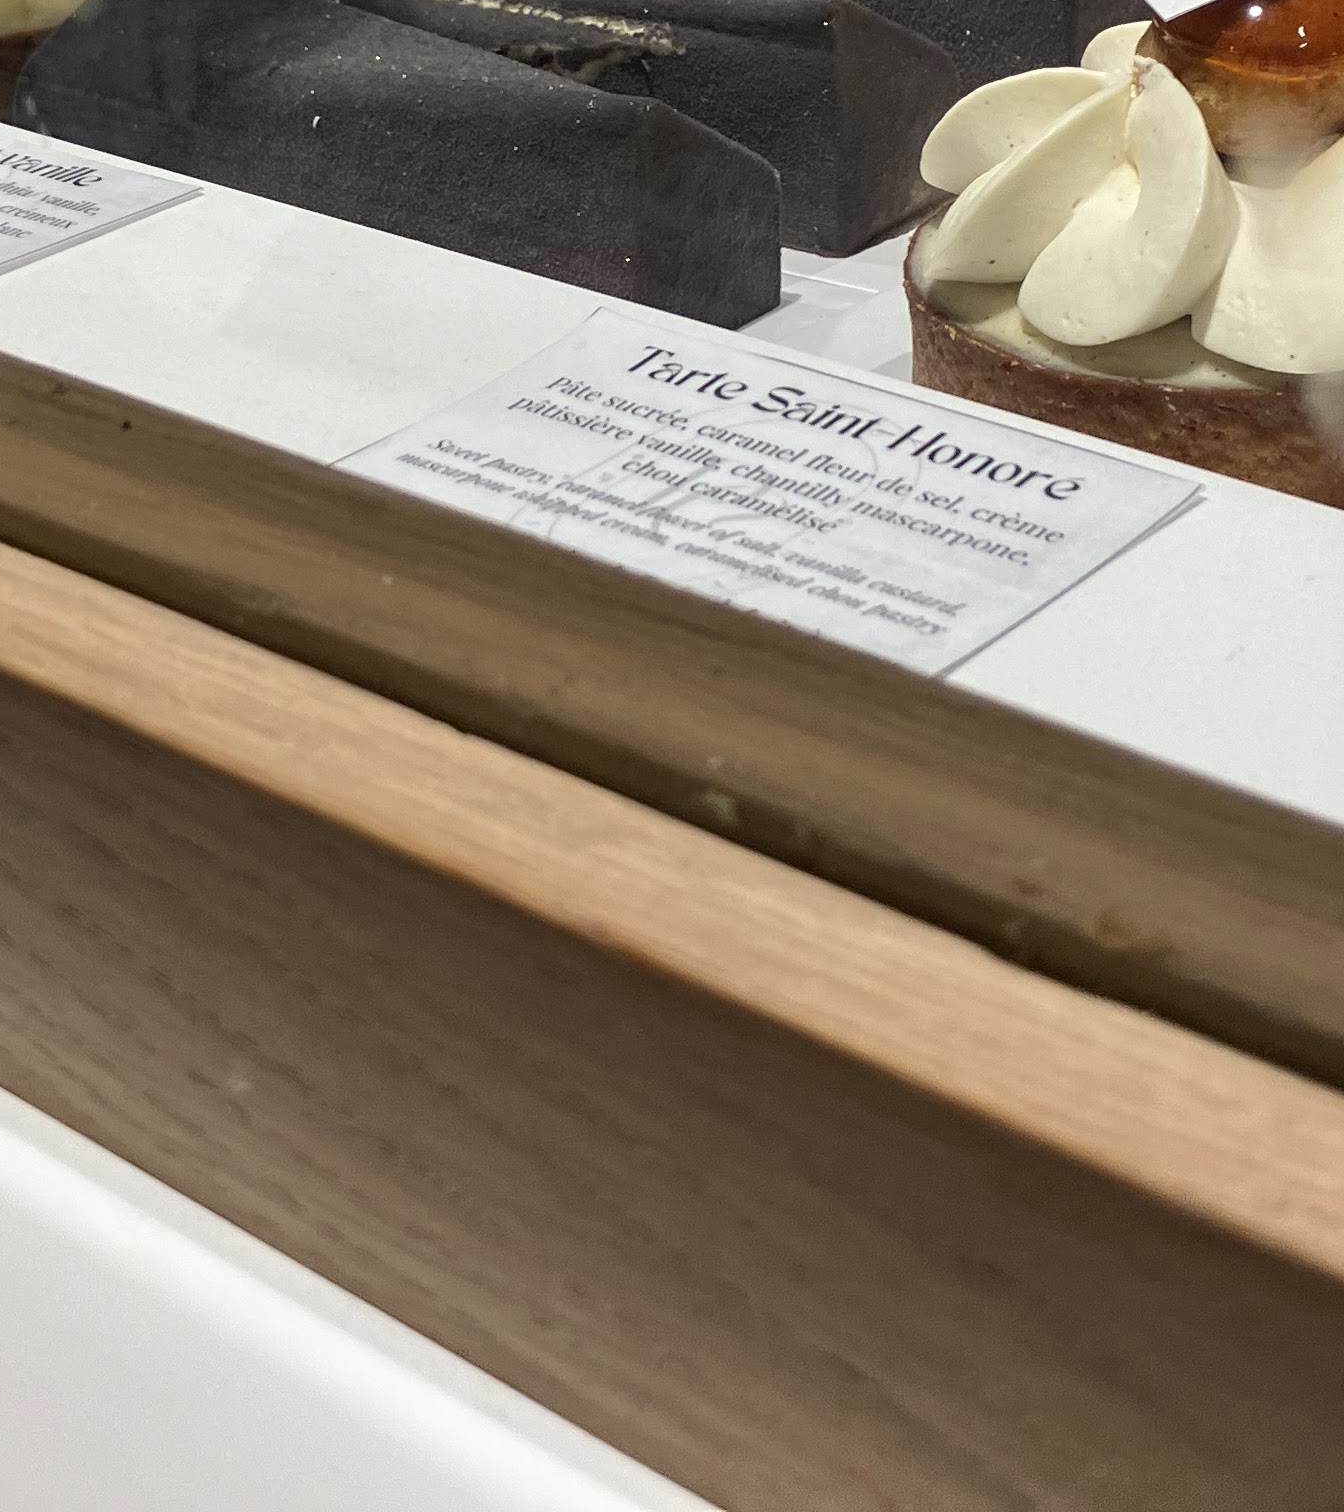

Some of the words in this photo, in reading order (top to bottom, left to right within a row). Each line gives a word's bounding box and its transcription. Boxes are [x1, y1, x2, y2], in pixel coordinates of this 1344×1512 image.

[39, 194, 101, 217] vanille,
[507, 397, 634, 441] pâtissière
[636, 434, 723, 471] vanille,
[729, 464, 851, 508] chantilly
[850, 501, 1029, 567] mascarpone,
[545, 376, 603, 402] Pâte
[601, 396, 689, 432] sucrée,
[696, 425, 809, 464] caramel
[803, 454, 877, 484] fleur
[875, 476, 914, 497] de
[914, 491, 965, 515] sel,
[969, 508, 1065, 544] crème
[621, 460, 699, 490] chou
[689, 482, 845, 533] caramélisé
[628, 345, 749, 401] Tarte
[751, 386, 1085, 501] Saint-Honoré
